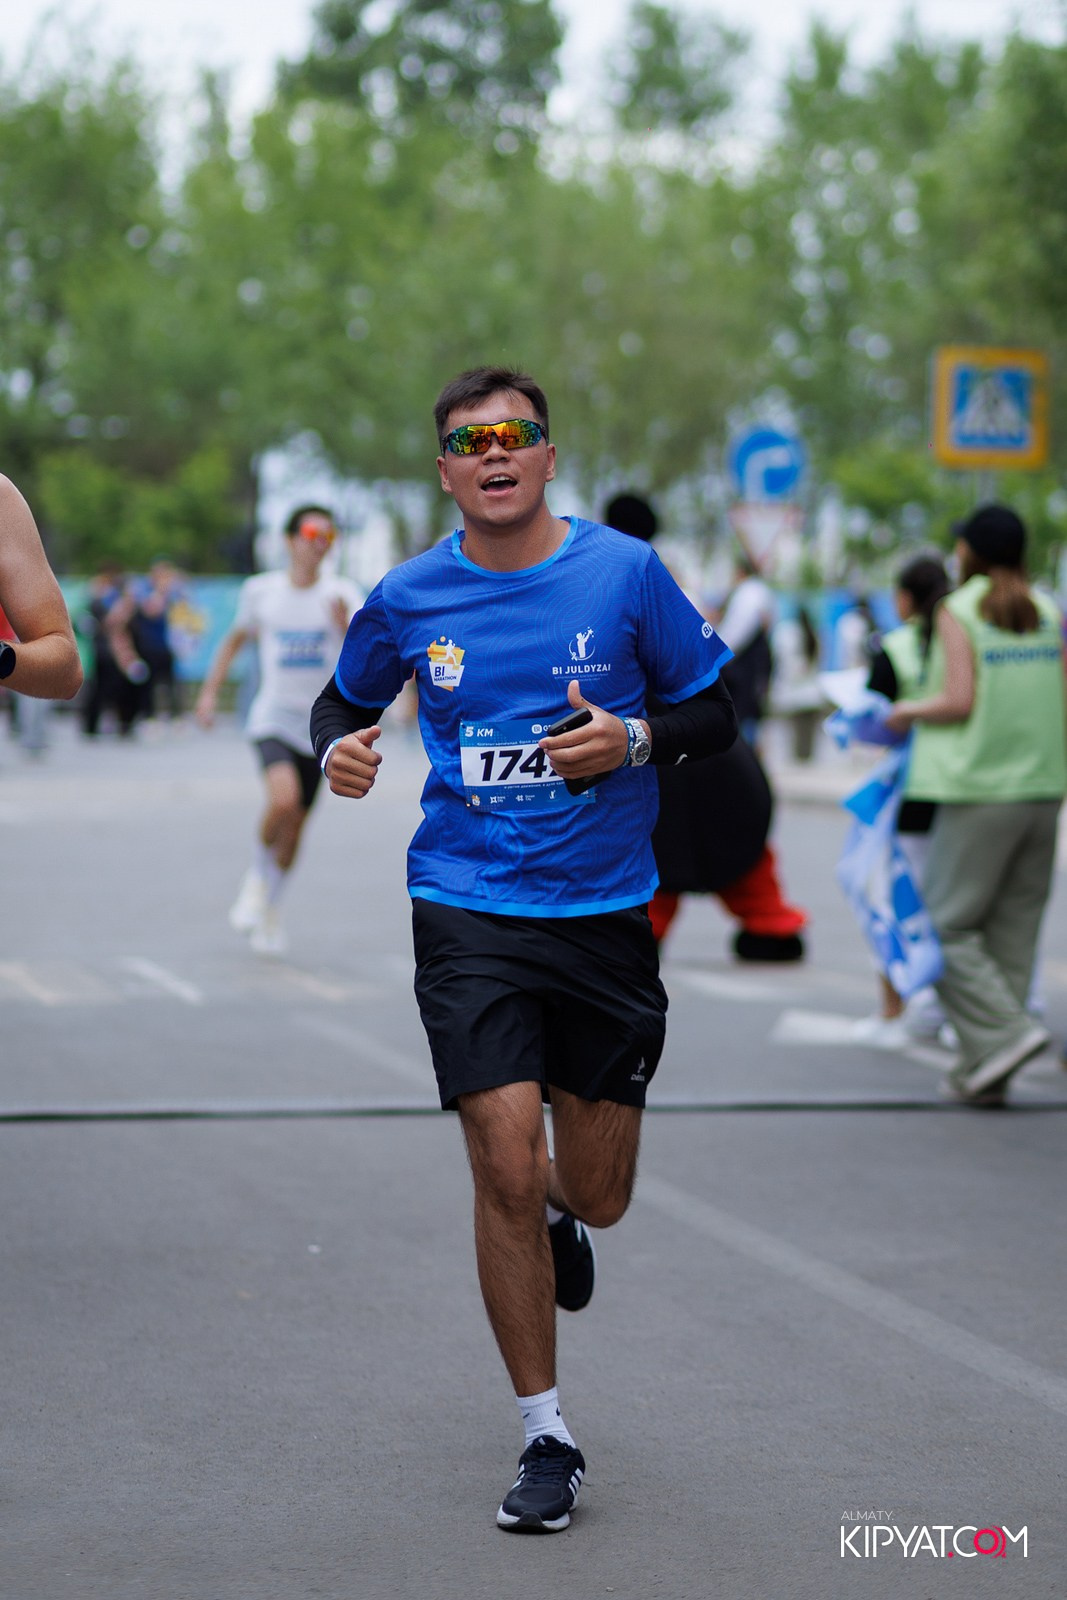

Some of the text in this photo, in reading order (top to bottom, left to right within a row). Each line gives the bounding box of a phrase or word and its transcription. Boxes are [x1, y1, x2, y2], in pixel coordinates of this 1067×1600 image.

[703, 624, 712, 636] BI
[434, 666, 445, 677] BI
[552, 664, 611, 675] BI JULDYZAI
[465, 726, 494, 738] 5 KM
[480, 747, 562, 782] 174
